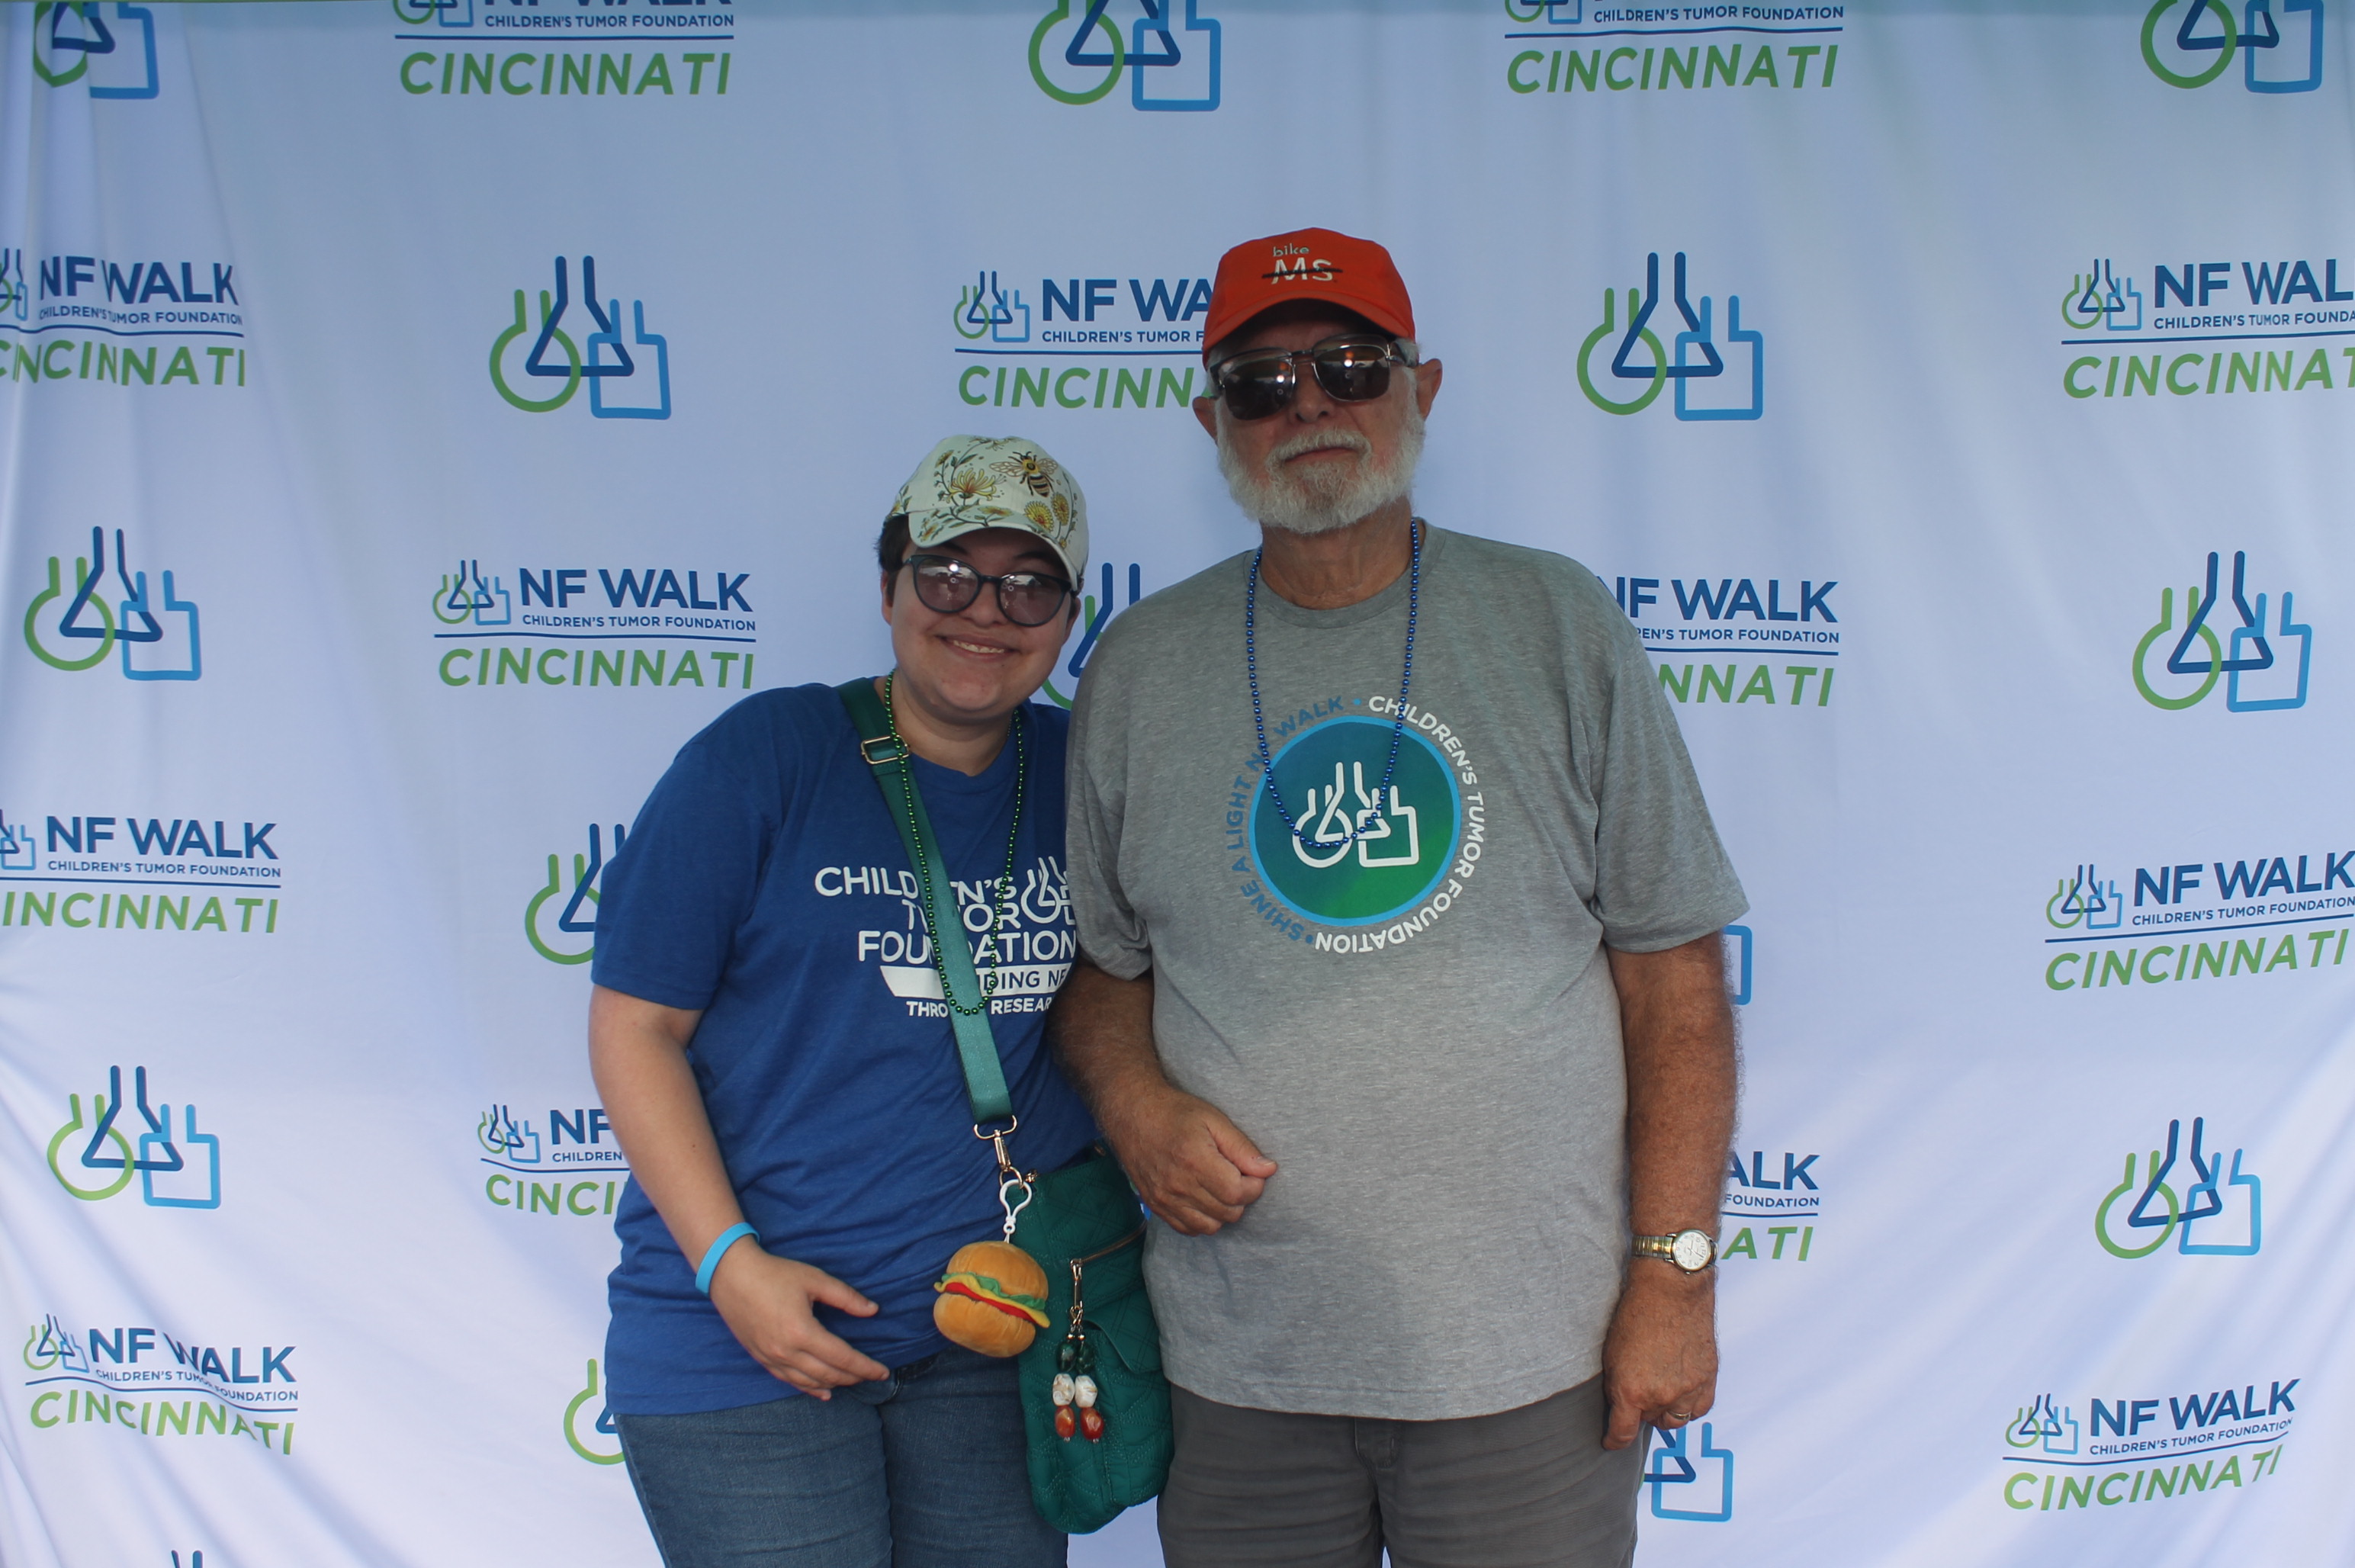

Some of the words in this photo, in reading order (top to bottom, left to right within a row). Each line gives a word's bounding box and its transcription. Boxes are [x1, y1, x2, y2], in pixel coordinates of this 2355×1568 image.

[485, 15, 572, 27] CHILDREN'S
[576, 16, 628, 27] TUMOR
[632, 14, 734, 27] FOUNDATION
[1594, 8, 1679, 23] CHILDREN'S
[1684, 5, 1737, 20] TUMOR
[1743, 6, 1844, 21] FOUNDATION
[400, 52, 731, 95] CINCINNATI
[1507, 43, 1839, 94] CINCINNATI
[1271, 257, 1333, 284] MS
[1273, 243, 1309, 257] bike
[40, 256, 95, 300] NF
[101, 262, 239, 306] WALK
[1043, 279, 1117, 321] NF
[1129, 279, 1213, 322] WA
[2154, 262, 2231, 307] NF
[2241, 259, 2355, 304] WAL
[39, 305, 107, 320] CHILDREN'S
[156, 311, 243, 326] FOUNDATION
[2154, 314, 2245, 329] CHILDREN'S
[2249, 313, 2289, 326] TUMOR
[1042, 331, 1133, 343] CHILDREN'S
[1137, 331, 1190, 342] TUMOR
[959, 365, 1205, 409] CINCINN
[519, 567, 587, 609] NF
[598, 568, 753, 612] WALK
[1671, 579, 1838, 623] WALK
[522, 615, 605, 628] CHILDREN'S
[609, 616, 660, 628] TUMOR
[665, 617, 756, 631] FOUNDATION
[1679, 628, 1733, 641] TUMOR
[1738, 629, 1839, 643] FOUNDATION
[439, 647, 754, 689] CINCINNATI
[1659, 664, 1834, 707] NNATI
[1273, 696, 1344, 737] WALK
[1369, 696, 1477, 786] CHILDREN'S
[1226, 776, 1251, 850] LIGHT
[47, 816, 116, 853] NF
[126, 818, 278, 860] WALK
[1454, 792, 1485, 879] TUMOR
[48, 860, 132, 872] CHILDREN'S
[136, 863, 185, 875] TUMOR
[191, 864, 281, 877] FOUNDATION
[814, 866, 1017, 904] CHILDN'S
[1232, 856, 1250, 872] A
[2134, 864, 2203, 907] NF
[2213, 850, 2355, 900] WALK
[2, 891, 278, 933] INCINNATI
[1241, 880, 1305, 942] SHINE
[1316, 879, 1463, 953] FOUNDATION
[2132, 909, 2213, 926] CHILDREN'S
[2218, 905, 2265, 919] TUMOR
[2270, 896, 2355, 914] FOUNDATION
[2045, 928, 2349, 991] CINCINNATI
[984, 971, 1040, 991] DING
[906, 1001, 948, 1017] THRO
[991, 997, 1052, 1014] RESEAR
[550, 1109, 611, 1145] NF
[552, 1152, 623, 1162] CHILDREN
[1728, 1151, 1820, 1190] ALK
[486, 1174, 616, 1216] CINCI
[88, 1328, 156, 1364] NF
[163, 1332, 297, 1383] WALK
[96, 1370, 172, 1382] CHILDREN'S
[31, 1389, 294, 1455] CINCINNATI
[2090, 1398, 2159, 1437] NF
[2169, 1378, 2301, 1431] WALK
[2090, 1439, 2167, 1455] CHILDREN'S
[2171, 1432, 2214, 1448] TUMOR
[2218, 1417, 2292, 1440] FOUNDATION
[2003, 1444, 2283, 1510] CINCINNATI
